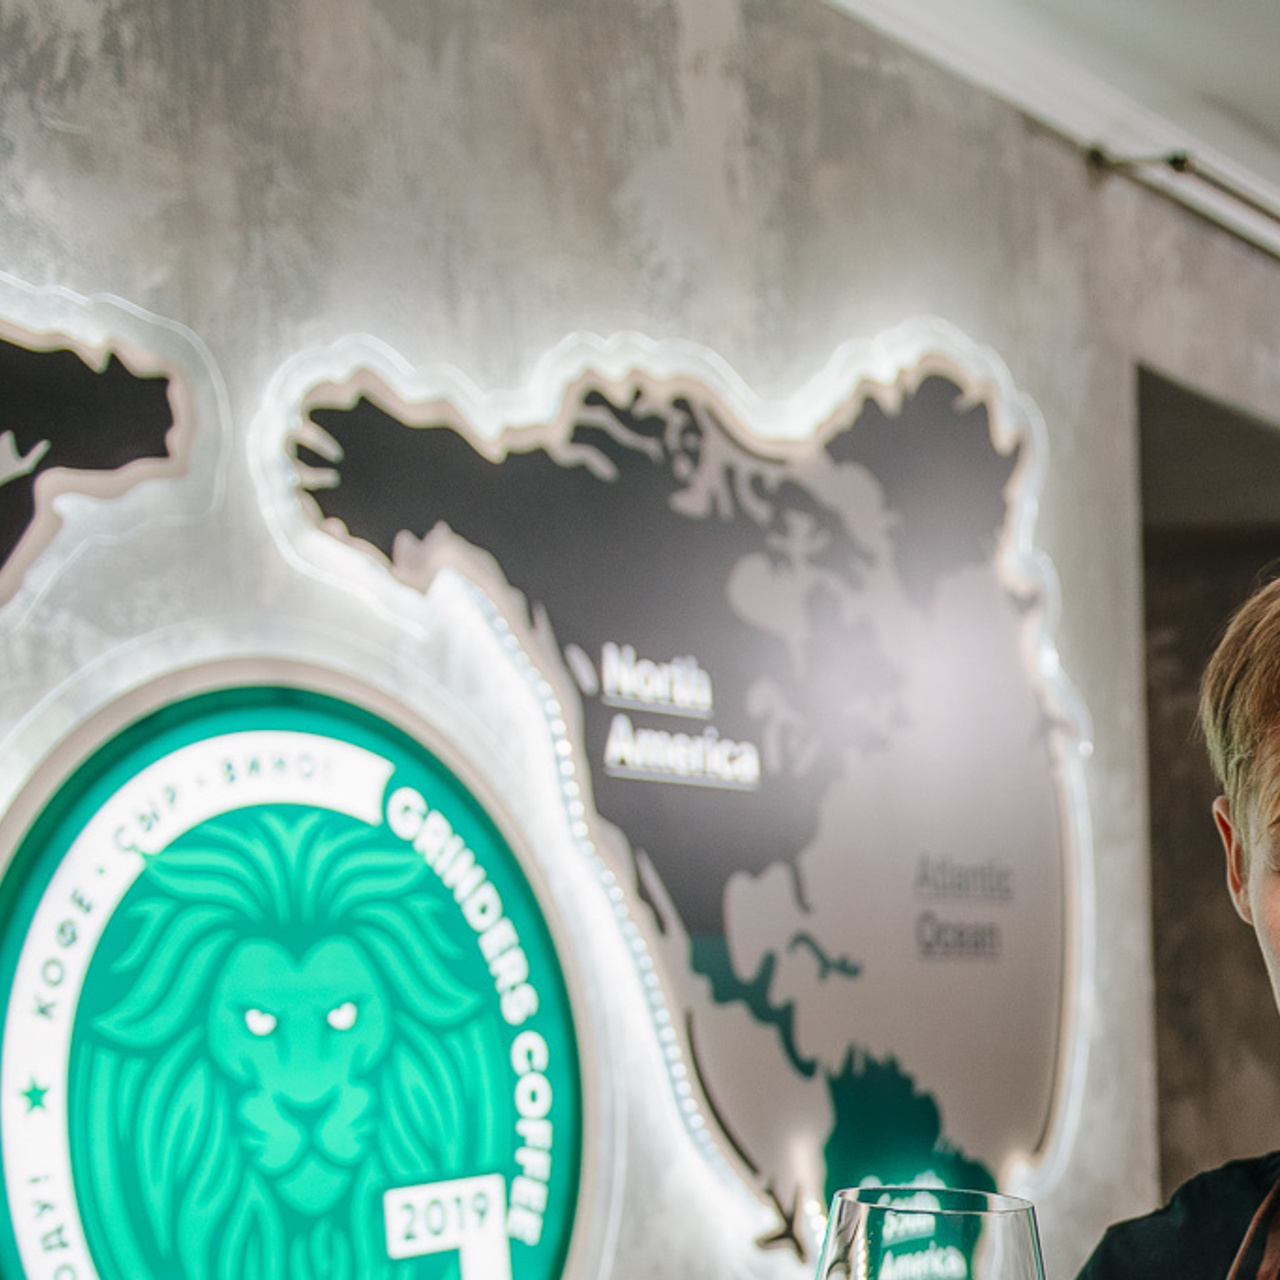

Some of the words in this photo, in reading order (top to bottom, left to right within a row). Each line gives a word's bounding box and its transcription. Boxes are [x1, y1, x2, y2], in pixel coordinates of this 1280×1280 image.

[601, 641, 713, 712] North
[604, 713, 761, 785] America
[913, 856, 1014, 900] Atlantic
[914, 909, 1000, 952] Ocean
[386, 786, 540, 1026] GRINDERS
[507, 1030, 553, 1247] COFFEE
[401, 1191, 489, 1242] 2019
